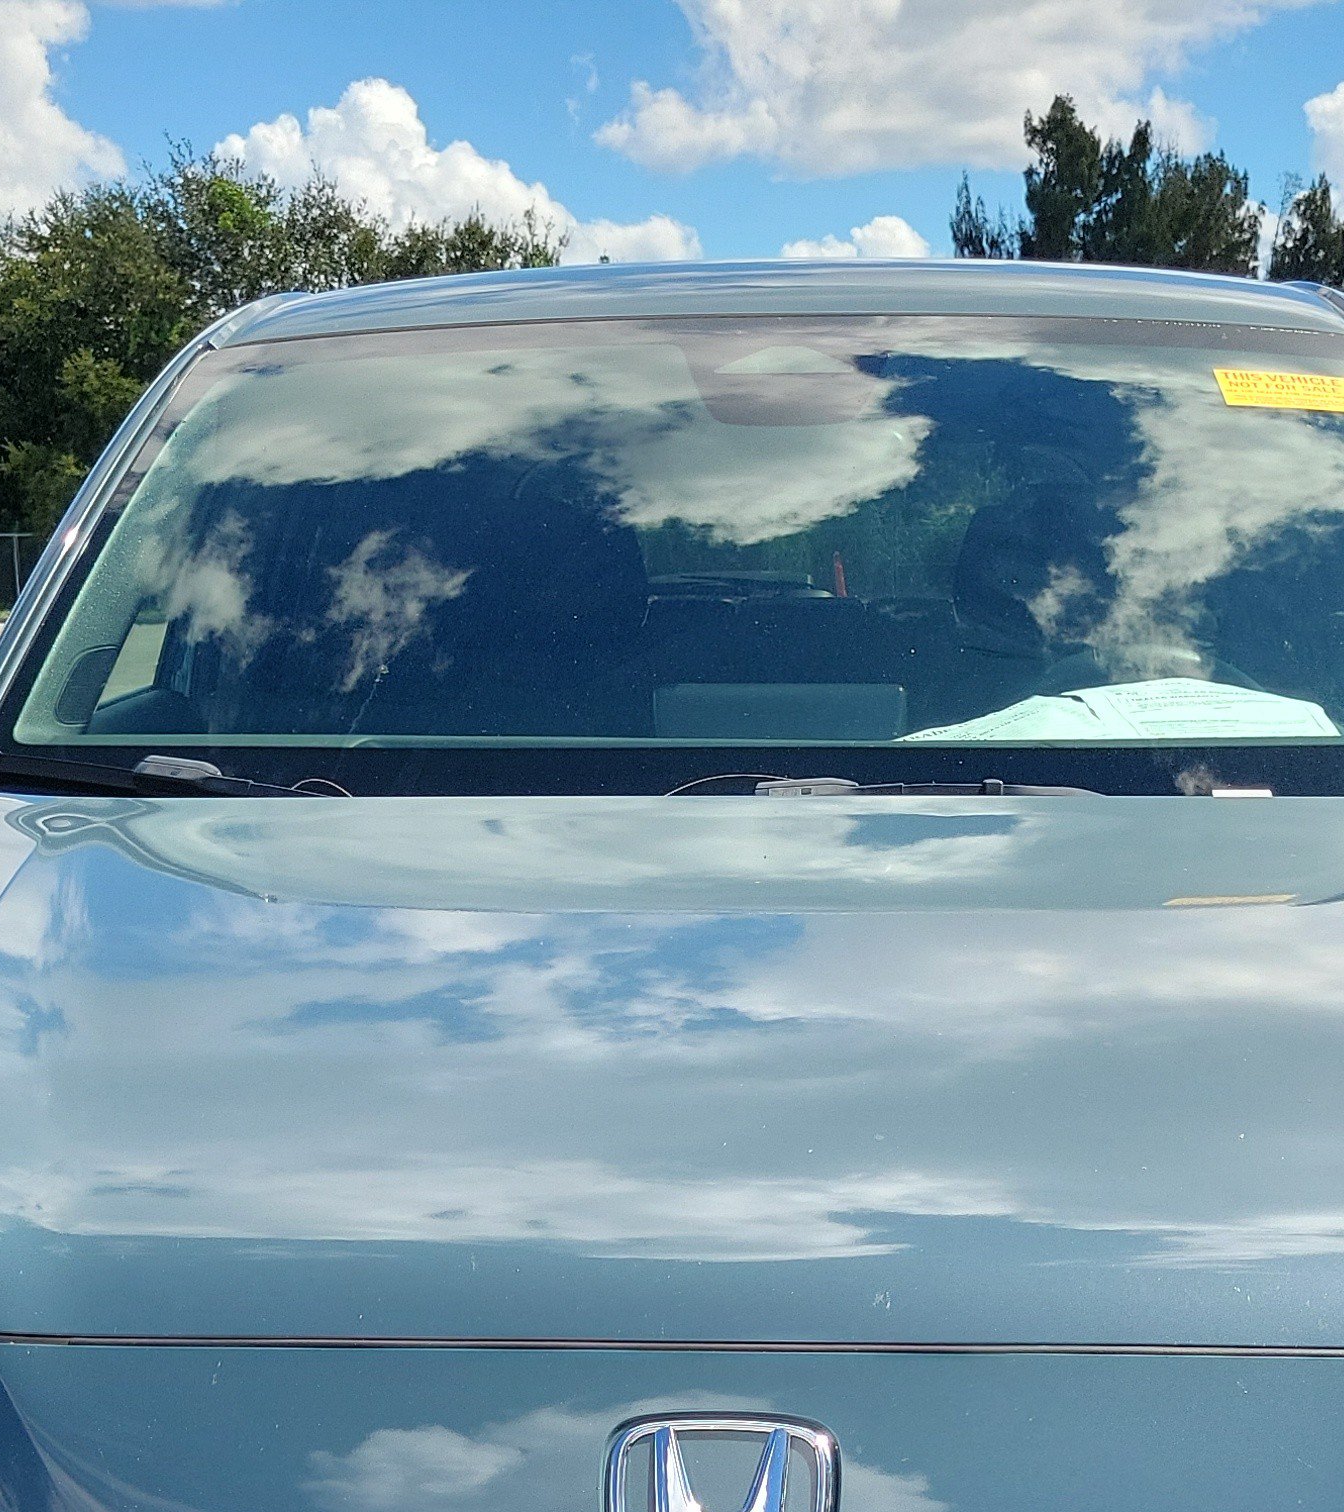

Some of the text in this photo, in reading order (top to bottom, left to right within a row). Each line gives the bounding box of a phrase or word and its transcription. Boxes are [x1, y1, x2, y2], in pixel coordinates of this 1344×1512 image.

[1221, 371, 1340, 386] THIS VEHICLE
[1229, 381, 1341, 394] NOT FOR SALE
